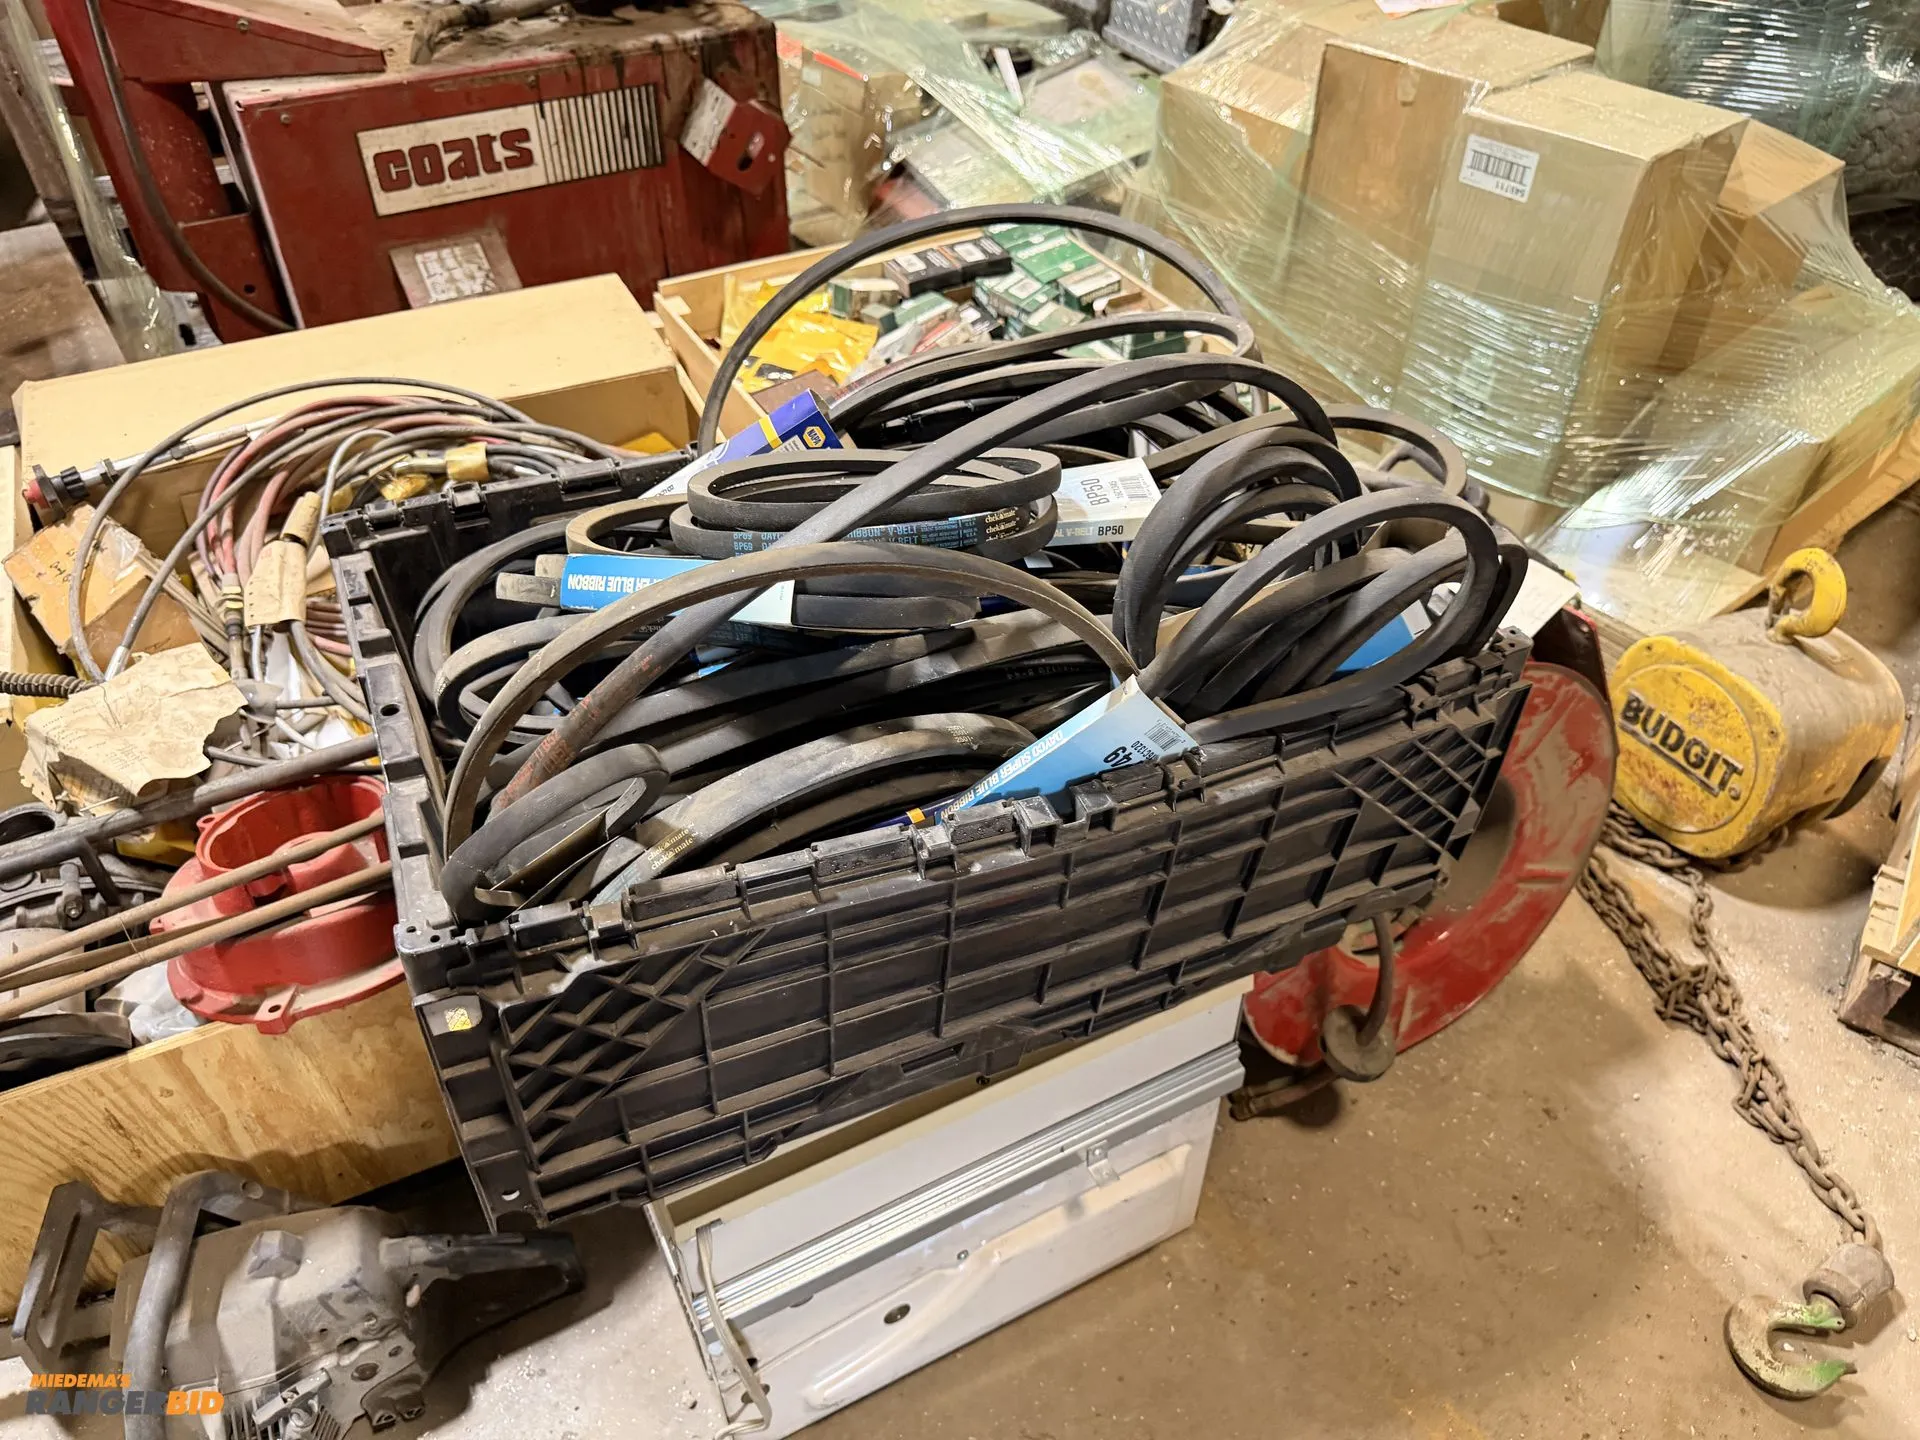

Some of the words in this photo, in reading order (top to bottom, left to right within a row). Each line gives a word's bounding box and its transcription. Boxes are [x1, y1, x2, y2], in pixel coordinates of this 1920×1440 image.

[373, 127, 534, 193] coats
[806, 428, 823, 447] NAPA
[1080, 478, 1111, 506] BP50
[1097, 524, 1124, 536] BP50
[734, 541, 753, 550] BP69
[567, 573, 607, 592] RIBBON
[606, 576, 634, 593] BLUE
[1032, 730, 1064, 757] DAYCO
[1620, 692, 1744, 792] BUDGIT
[1000, 752, 1032, 778] SUPER
[975, 775, 1001, 795] BLUE
